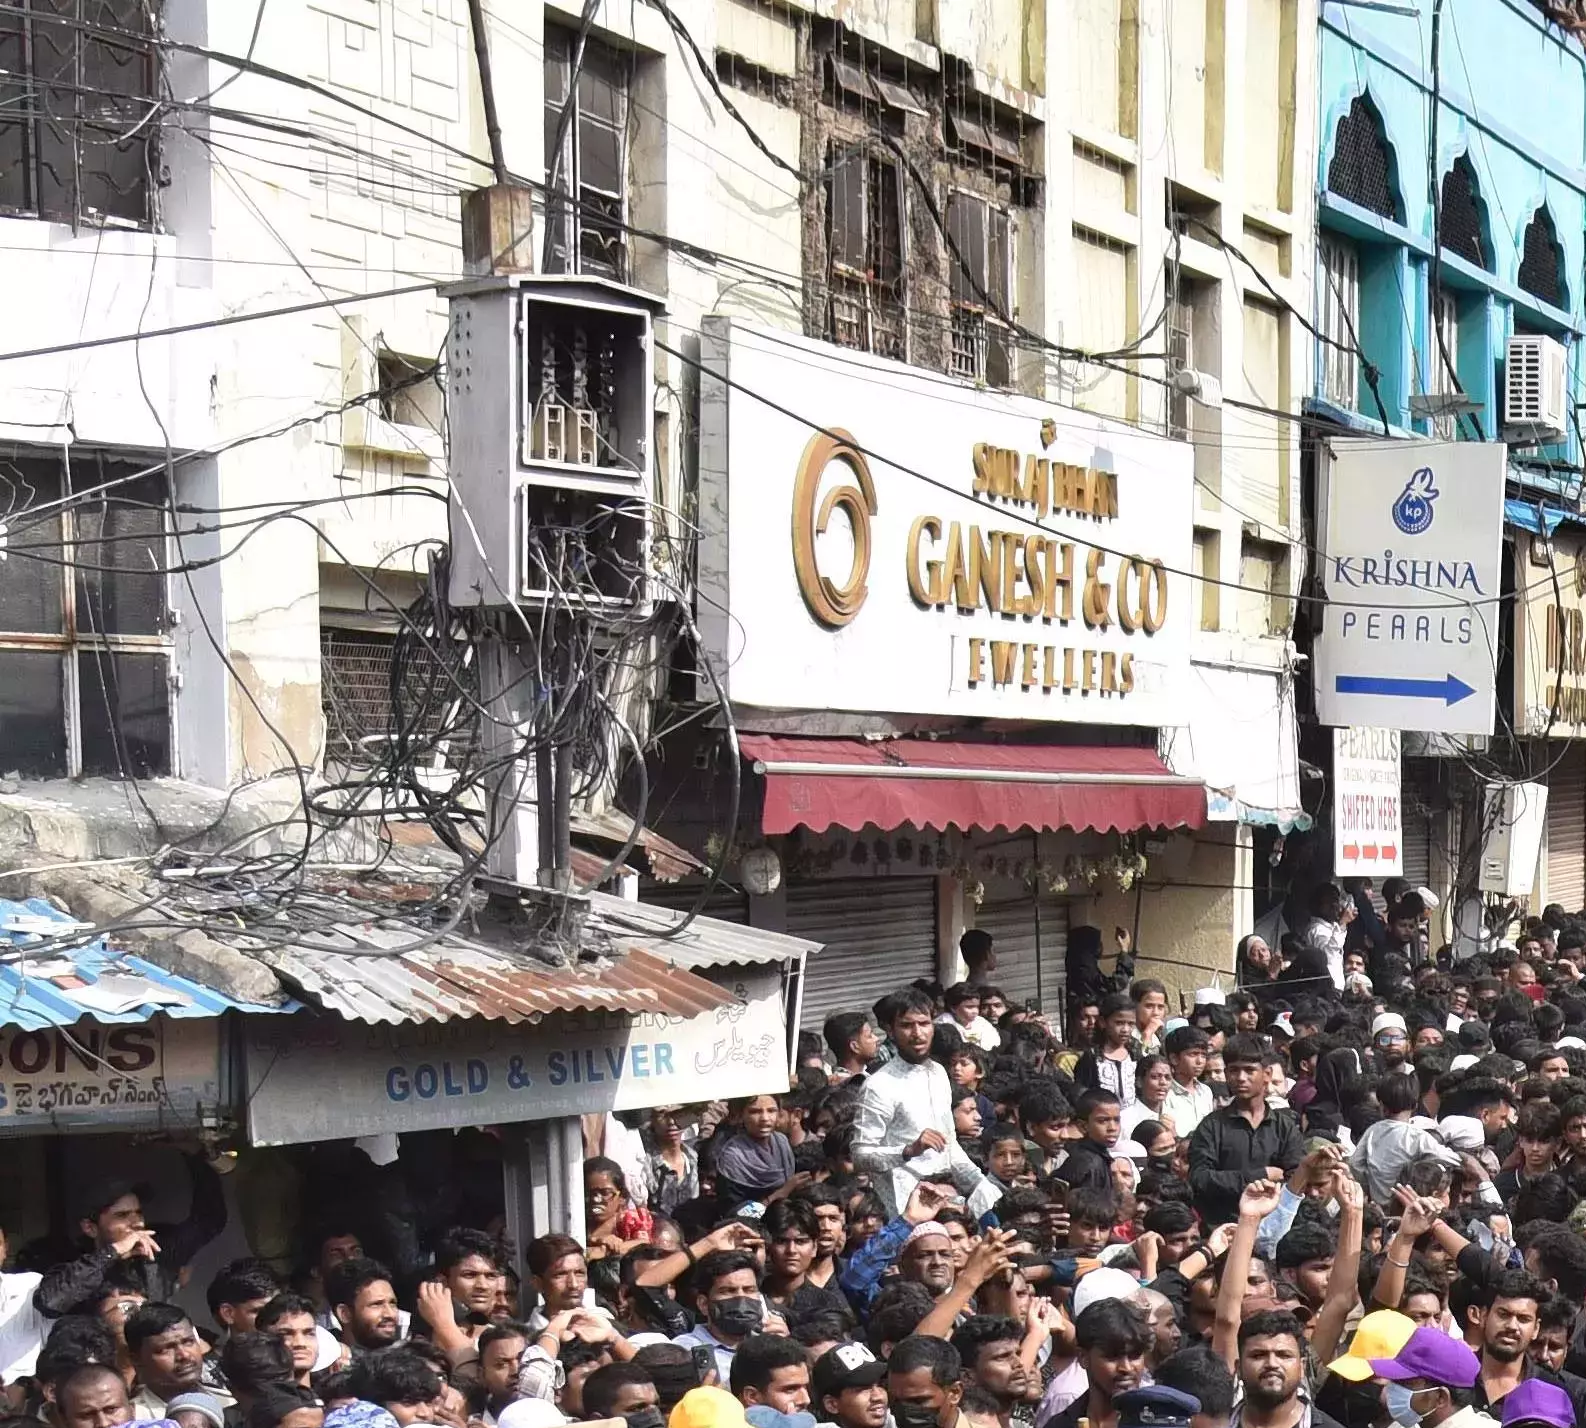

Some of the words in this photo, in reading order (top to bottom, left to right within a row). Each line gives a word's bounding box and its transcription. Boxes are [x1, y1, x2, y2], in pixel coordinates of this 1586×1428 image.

[973, 442, 1050, 520] SURAJ
[1052, 462, 1119, 522] BHAN
[1405, 504, 1423, 520] kp
[907, 516, 1076, 625] GANESH
[1083, 549, 1116, 632] &
[1117, 554, 1168, 636] CO
[1342, 611, 1472, 645] PEARLS
[1339, 726, 1398, 762] PEARLS
[1342, 792, 1375, 832] SHIFTED
[1377, 795, 1398, 832] HERE
[0, 1026, 156, 1074] ONS
[386, 1058, 489, 1101] GOLD
[507, 1055, 531, 1090] &
[547, 1042, 675, 1087] SILVER
